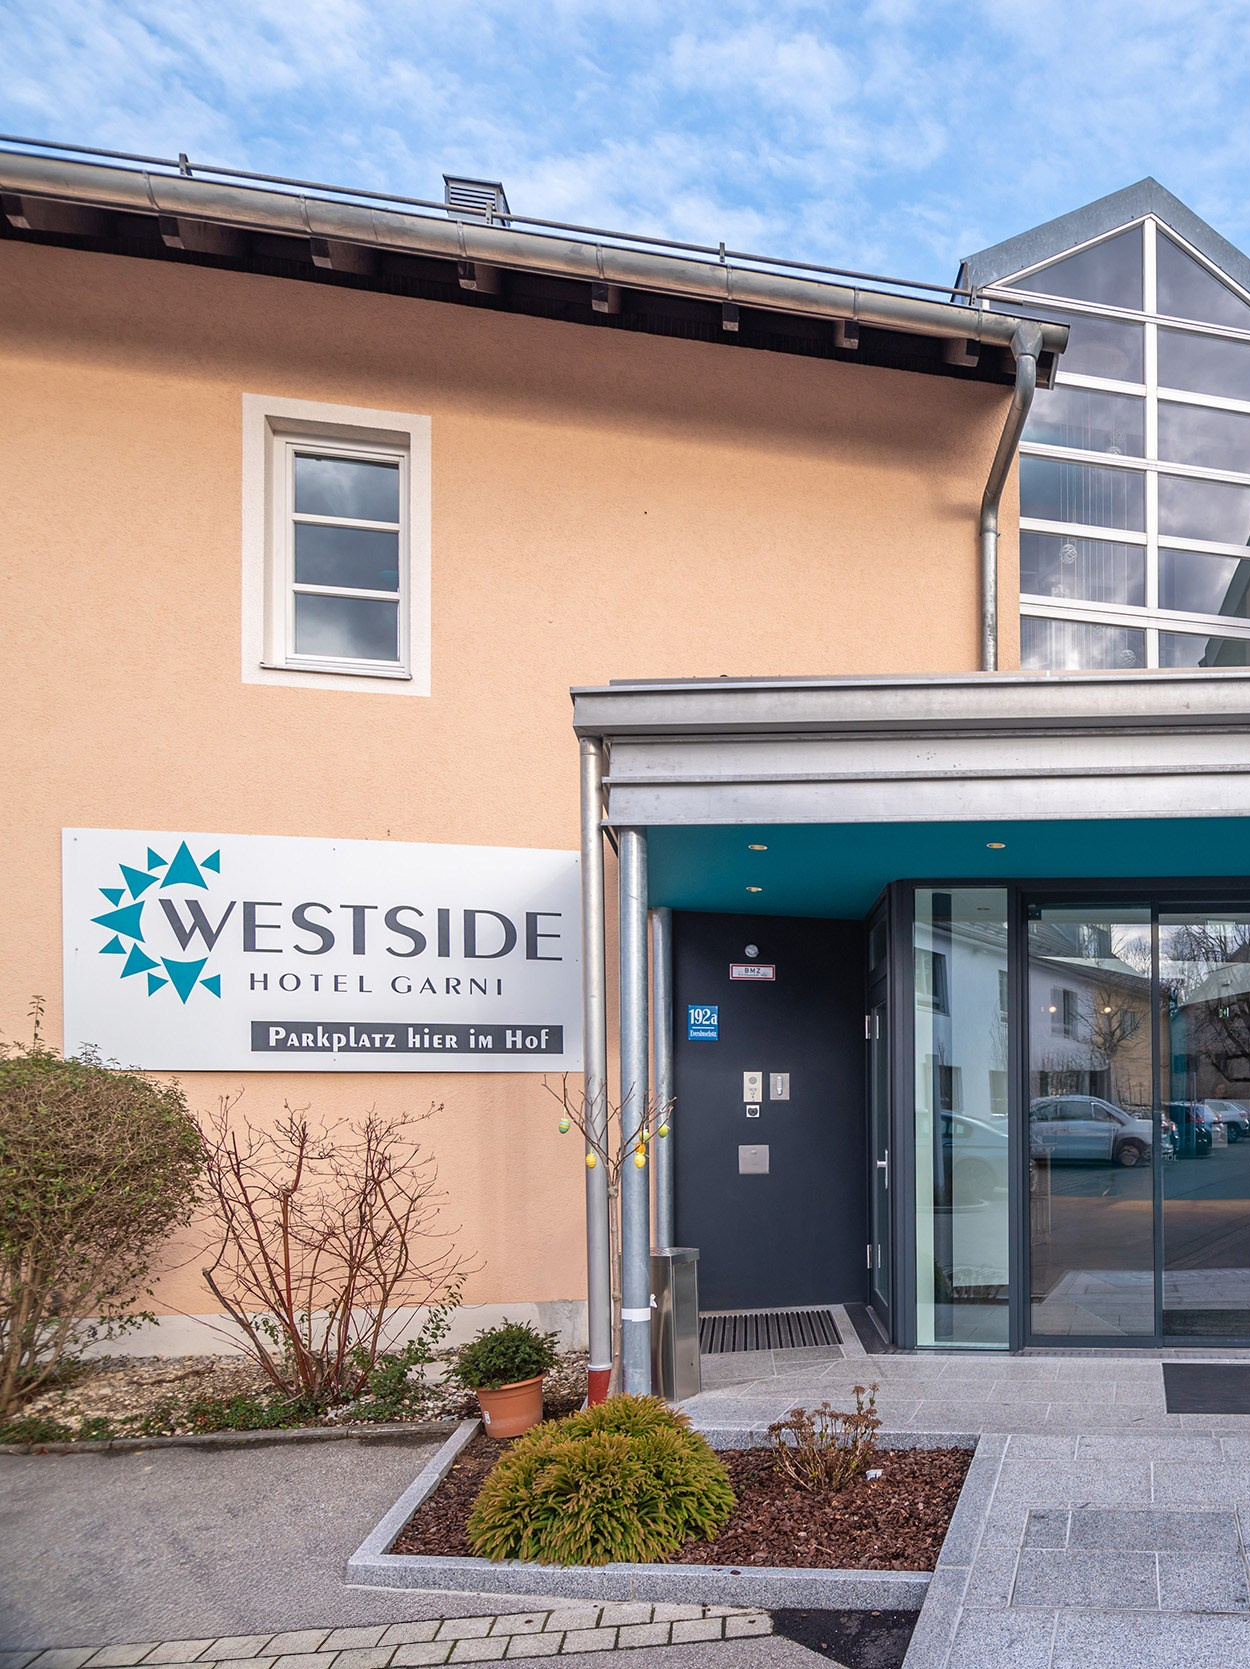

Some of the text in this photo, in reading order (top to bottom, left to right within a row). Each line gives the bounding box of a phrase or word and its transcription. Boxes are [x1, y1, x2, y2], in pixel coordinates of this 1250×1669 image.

[158, 898, 563, 962] WESTSIDE
[249, 972, 503, 996] HOTEL GARNI
[689, 1008, 718, 1025] 192a
[505, 1028, 550, 1049] Hof
